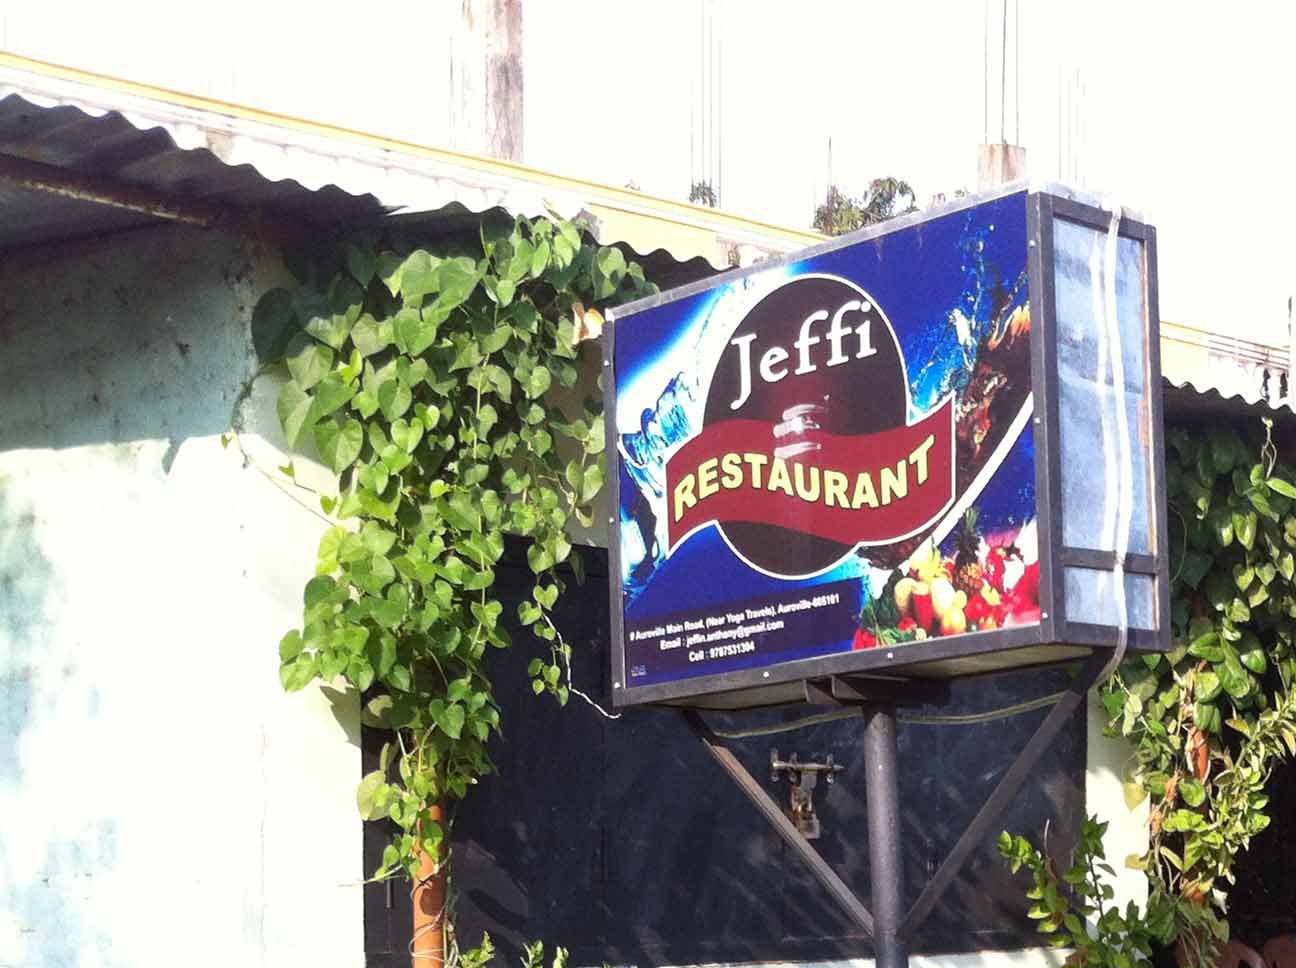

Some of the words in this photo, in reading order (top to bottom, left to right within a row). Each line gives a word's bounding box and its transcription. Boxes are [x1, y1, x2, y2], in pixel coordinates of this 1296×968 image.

[730, 300, 878, 410] Jeffi
[673, 435, 936, 523] RESTAURANT
[666, 622, 683, 635] Main
[688, 649, 705, 663] Cell
